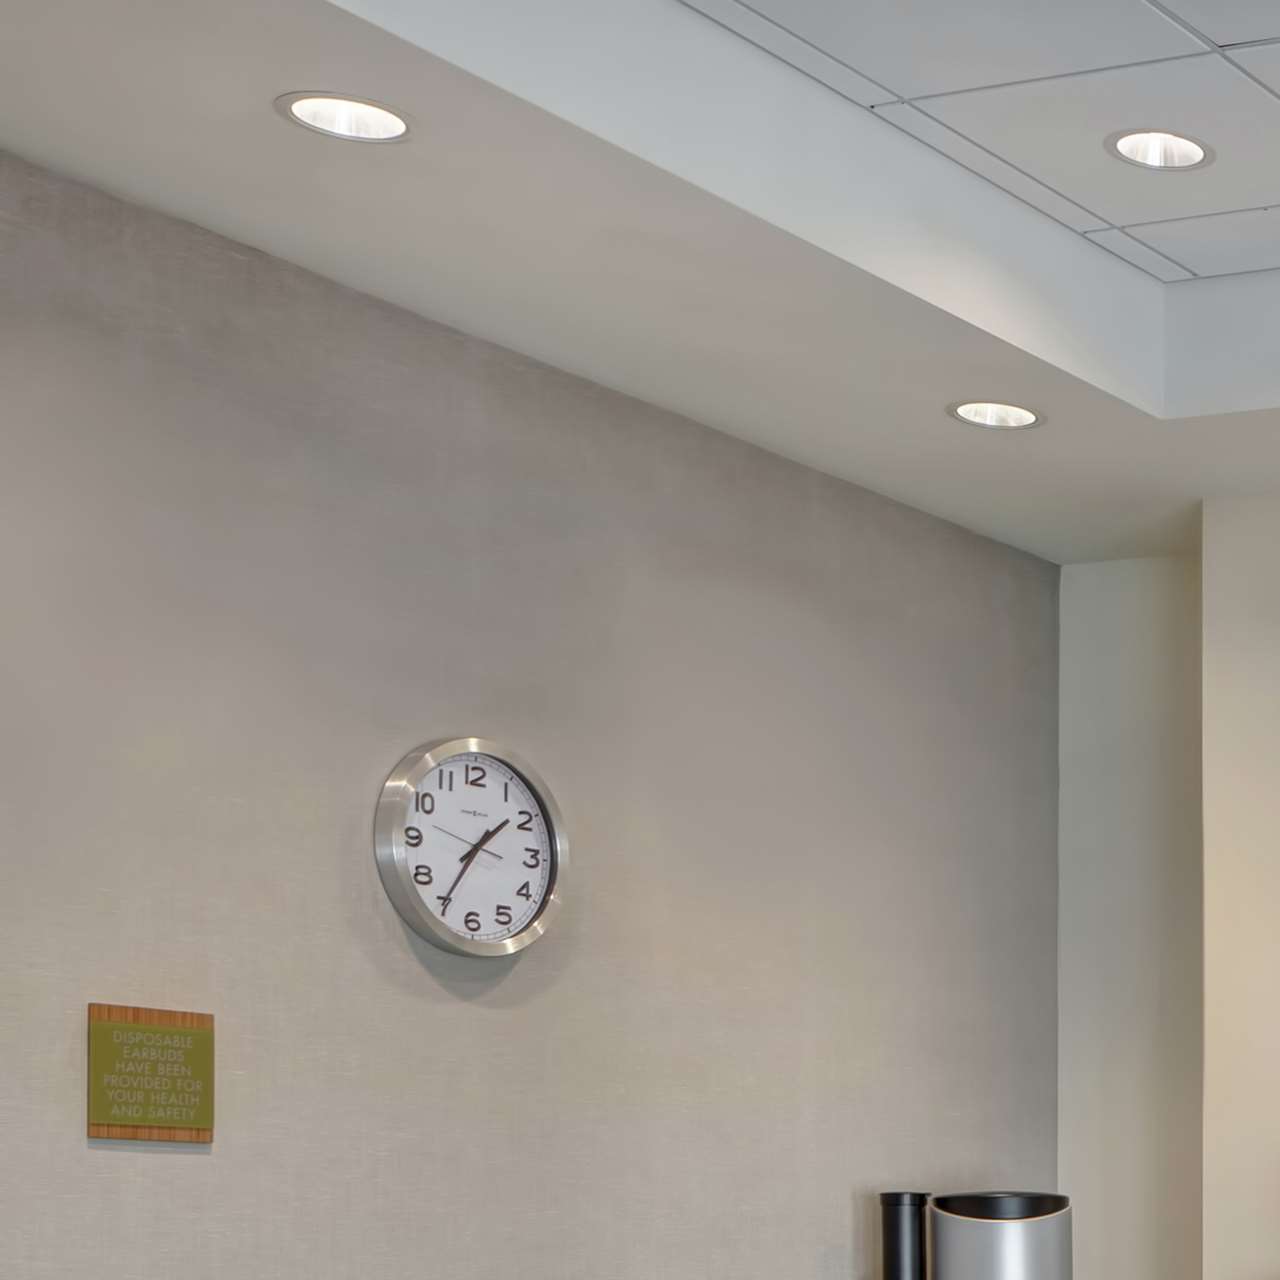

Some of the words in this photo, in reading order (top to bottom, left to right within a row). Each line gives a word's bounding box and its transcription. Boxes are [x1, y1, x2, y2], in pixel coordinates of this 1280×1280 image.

[438, 769, 454, 791] 11
[465, 764, 487, 788] 12
[503, 782, 509, 803] 1
[415, 791, 435, 815] 10
[516, 811, 533, 831] 2
[404, 826, 423, 848] 9
[523, 848, 540, 869] 3
[413, 865, 433, 886] 8
[516, 881, 532, 901] 4
[436, 895, 453, 917] 7
[495, 905, 513, 925] 5
[464, 911, 481, 932] 6
[112, 1030, 193, 1049] DISPOSABLE
[123, 1046, 185, 1062] EARBUDS
[115, 1061, 153, 1075] HAVE
[157, 1063, 192, 1077] BEEN
[104, 1074, 170, 1090] PROVIDED
[176, 1078, 202, 1092] FOR
[105, 1088, 144, 1103] YOUR
[151, 1091, 200, 1106] HEALTH
[112, 1103, 143, 1117] AND
[148, 1106, 198, 1120] SAFETY
